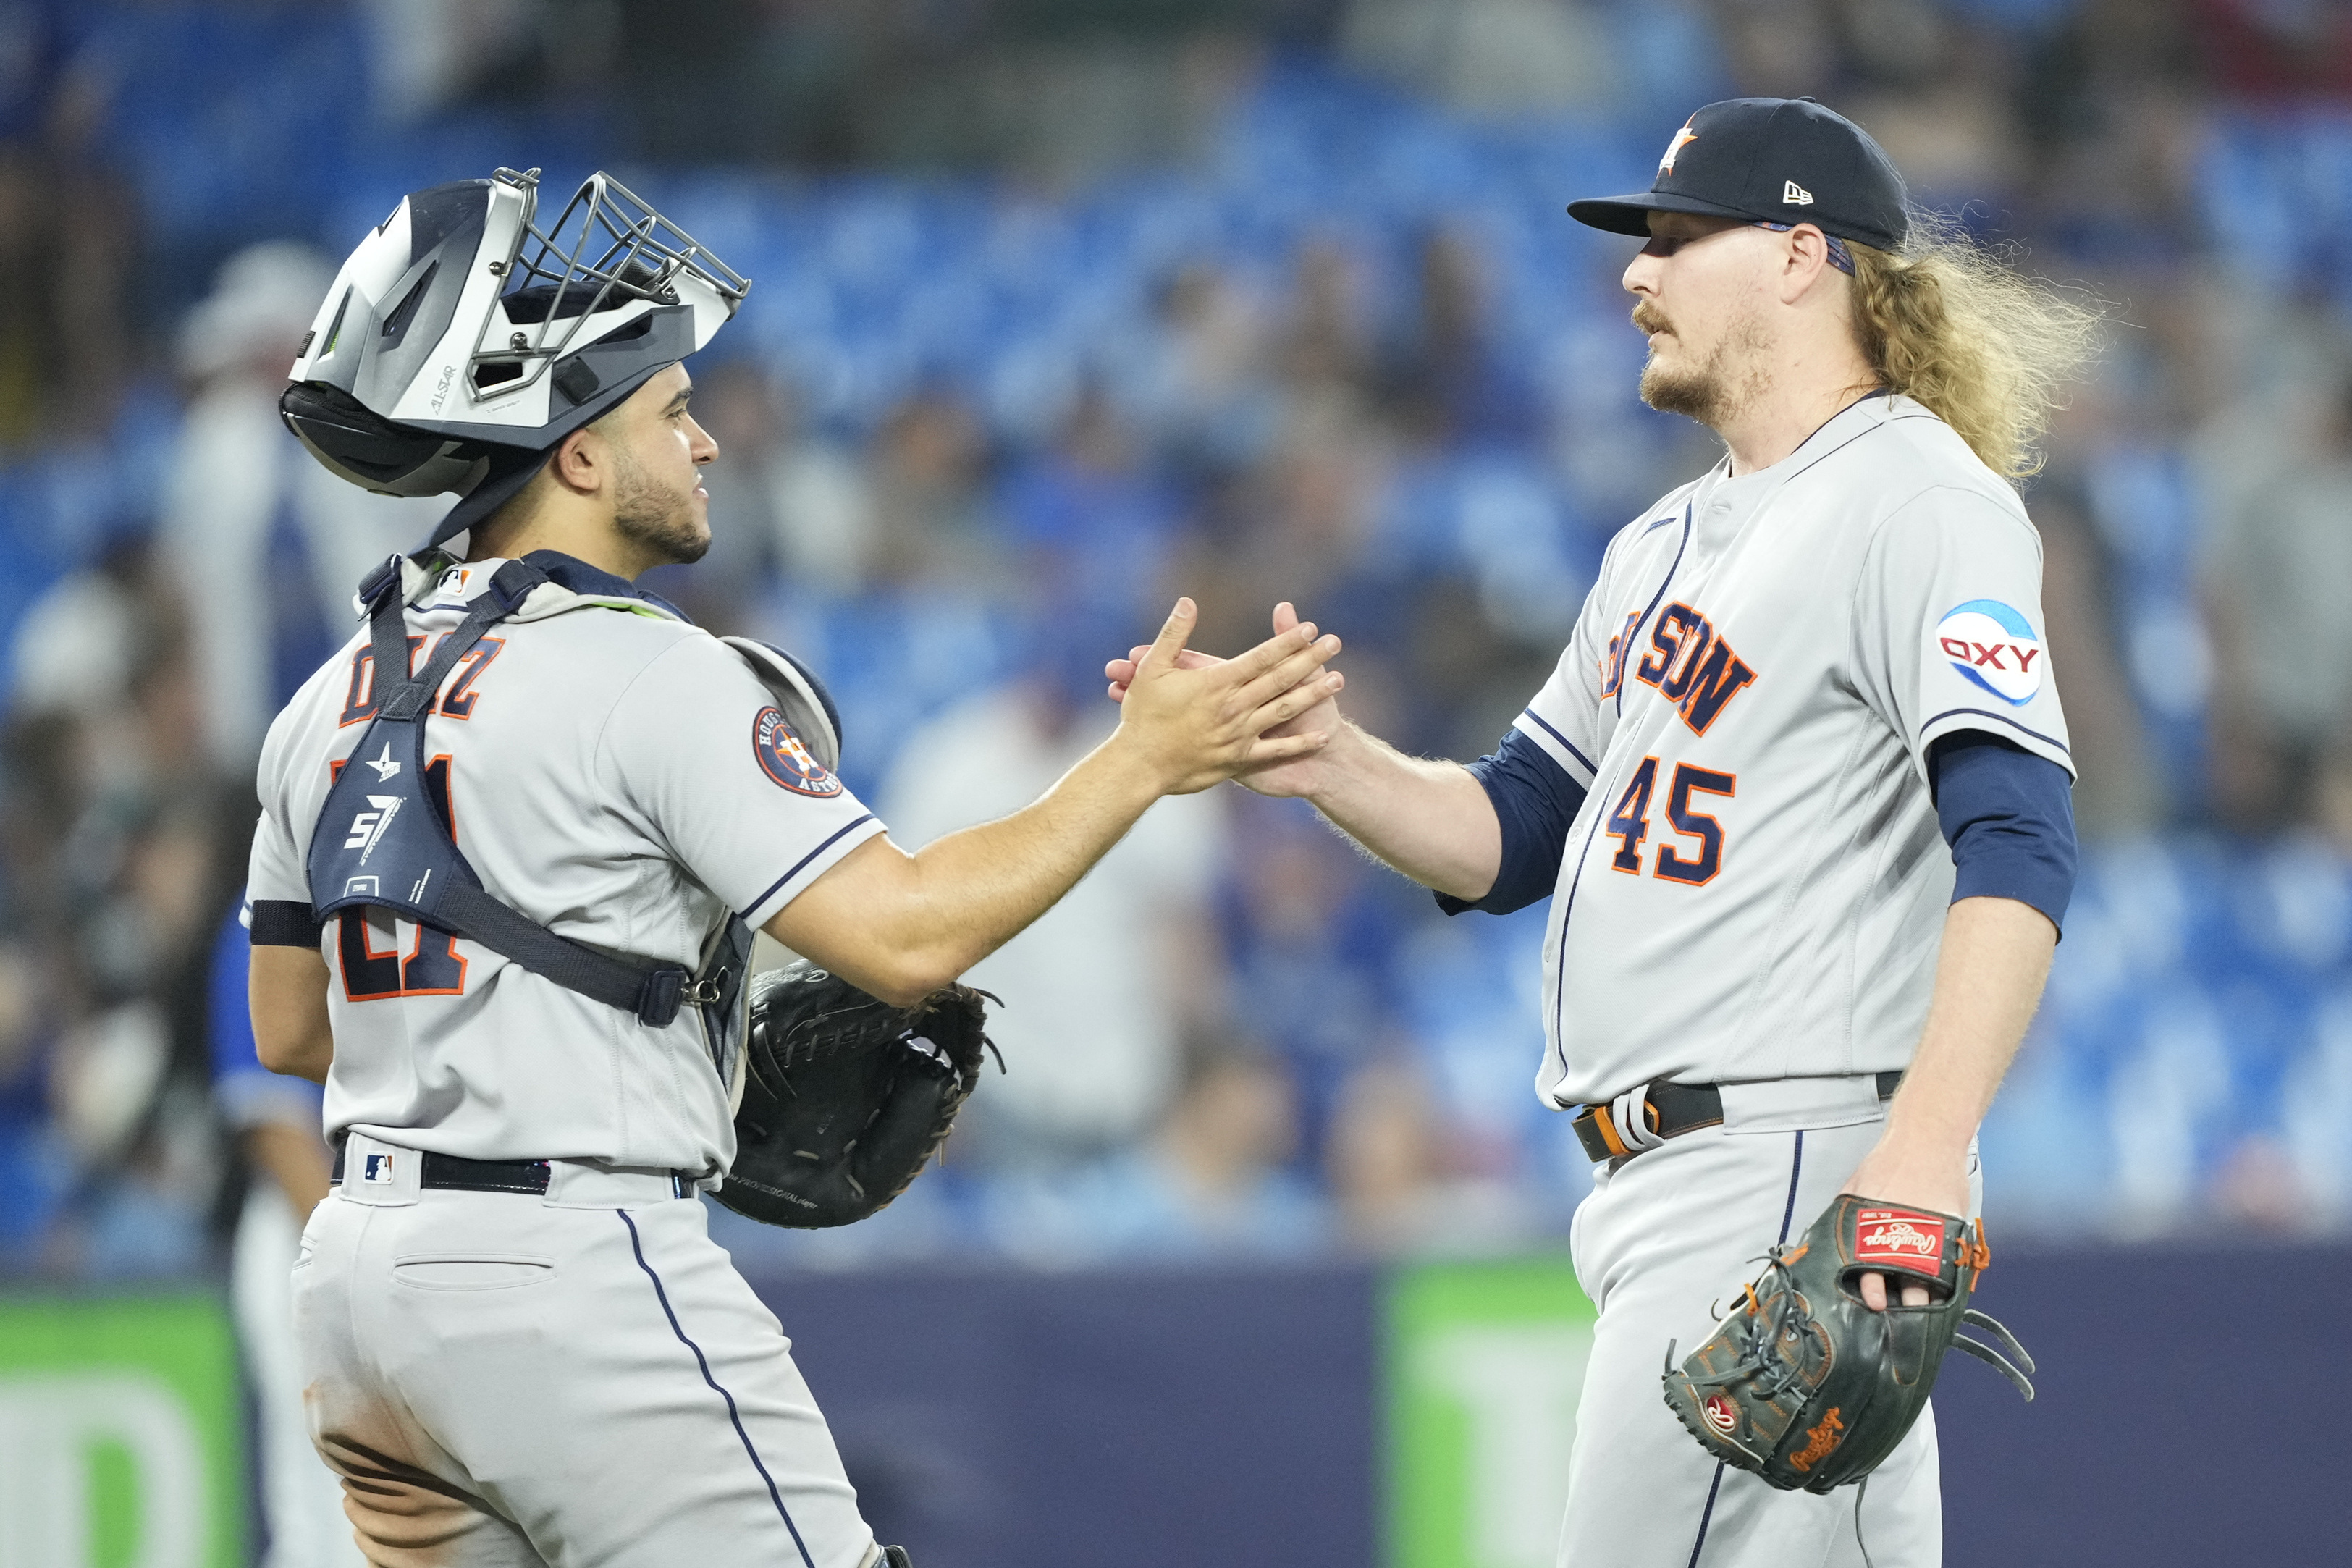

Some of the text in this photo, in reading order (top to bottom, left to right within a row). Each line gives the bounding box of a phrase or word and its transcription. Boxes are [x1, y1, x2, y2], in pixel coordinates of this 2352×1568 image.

[338, 631, 506, 729] DZ
[1940, 637, 2039, 673] OXY
[1606, 754, 1736, 887] 45
[1863, 1226, 1936, 1255] Rawlings
